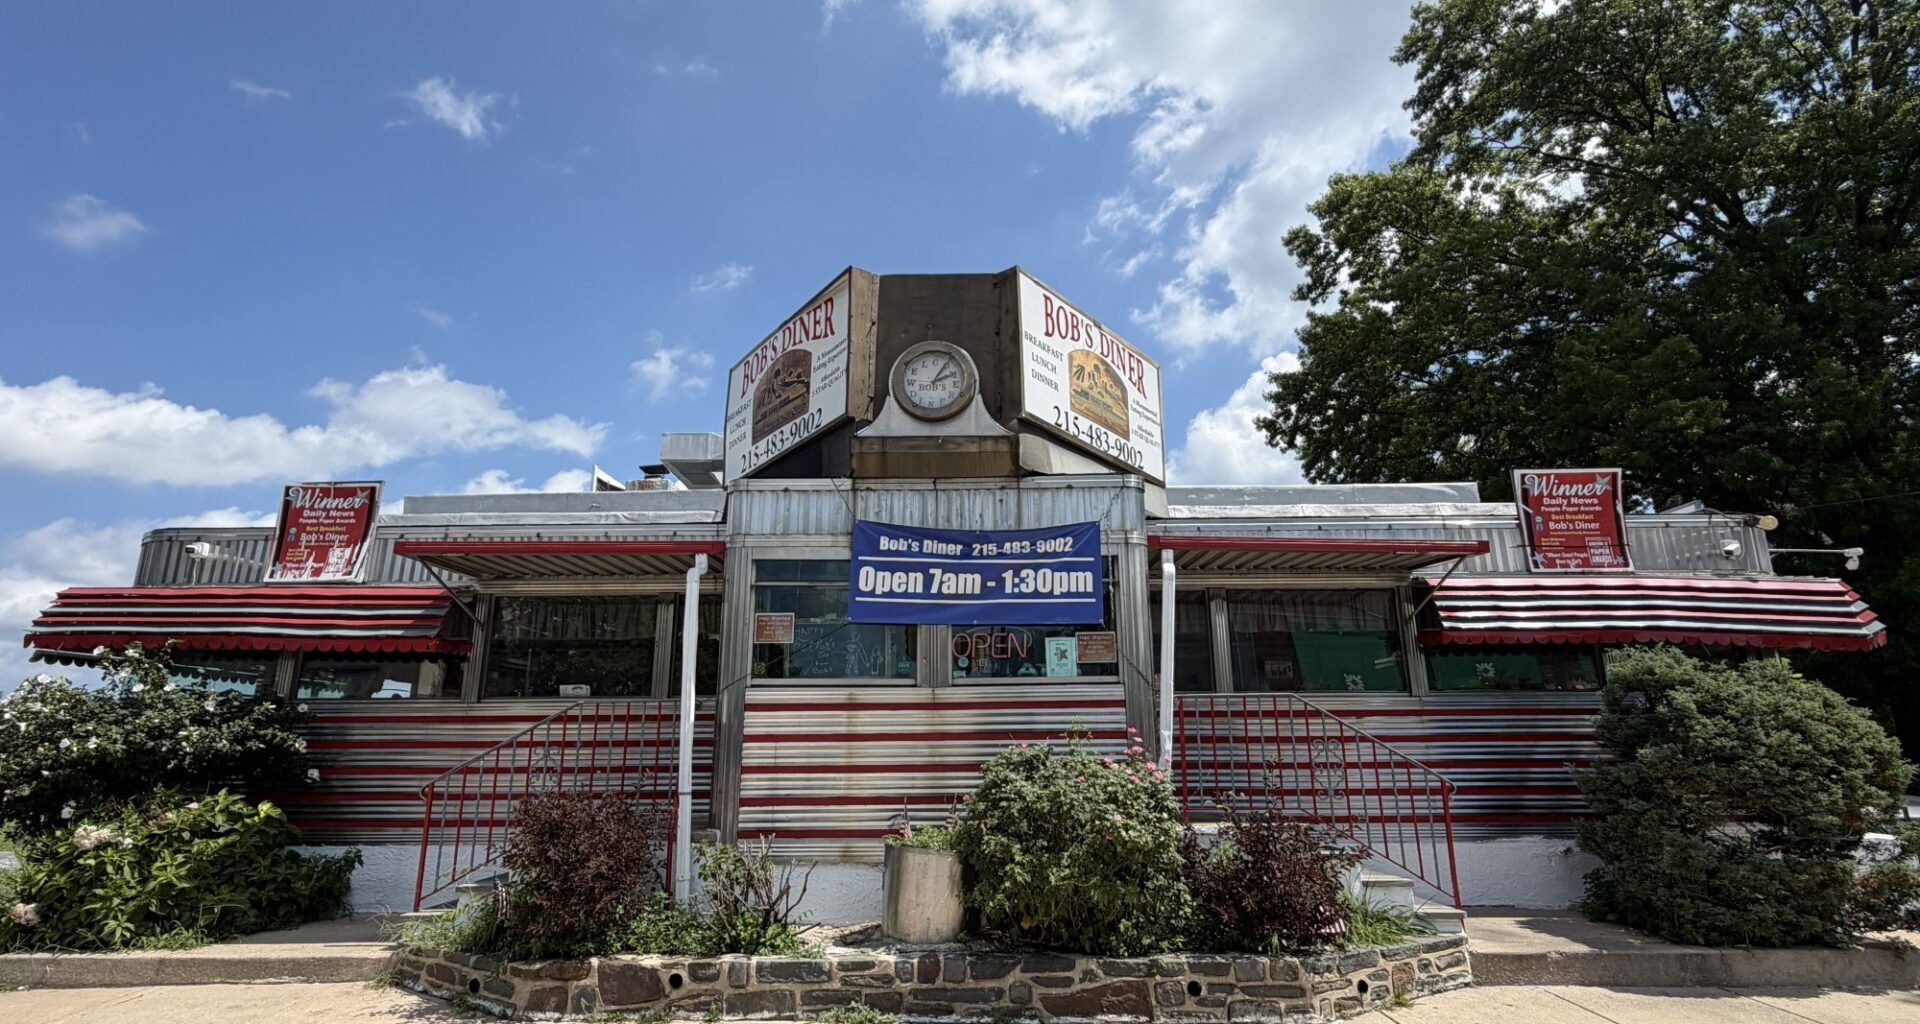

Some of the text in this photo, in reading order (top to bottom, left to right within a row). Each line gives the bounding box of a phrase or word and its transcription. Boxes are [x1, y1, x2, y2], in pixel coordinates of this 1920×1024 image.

[740, 296, 835, 399] BOB'S DINER
[1024, 331, 1064, 361] BREAKFAST
[1043, 293, 1147, 399] BOB'S DINER
[1031, 352, 1057, 374] LUNCH
[919, 383, 946, 391] BOB'S
[1031, 368, 1060, 392] DINNER
[727, 398, 753, 423] BREAKFAST
[730, 417, 747, 434] LUNCH
[729, 432, 747, 450] DINNER
[740, 407, 823, 473] 215-483-9002
[1053, 405, 1144, 470] 215-483-9002
[1524, 474, 1606, 496] Winner
[289, 487, 365, 509] Winner
[1543, 497, 1568, 505] Daily
[303, 510, 327, 518] Daily
[300, 532, 349, 541] Bob's Diner
[1549, 521, 1600, 530] Bob's Diner
[880, 535, 1073, 556] Bob's Diner 215-483-9002
[859, 565, 924, 595] Open
[929, 568, 981, 595] 7am
[1002, 568, 1094, 595] 1:30pm
[953, 633, 1027, 658] OPEN
